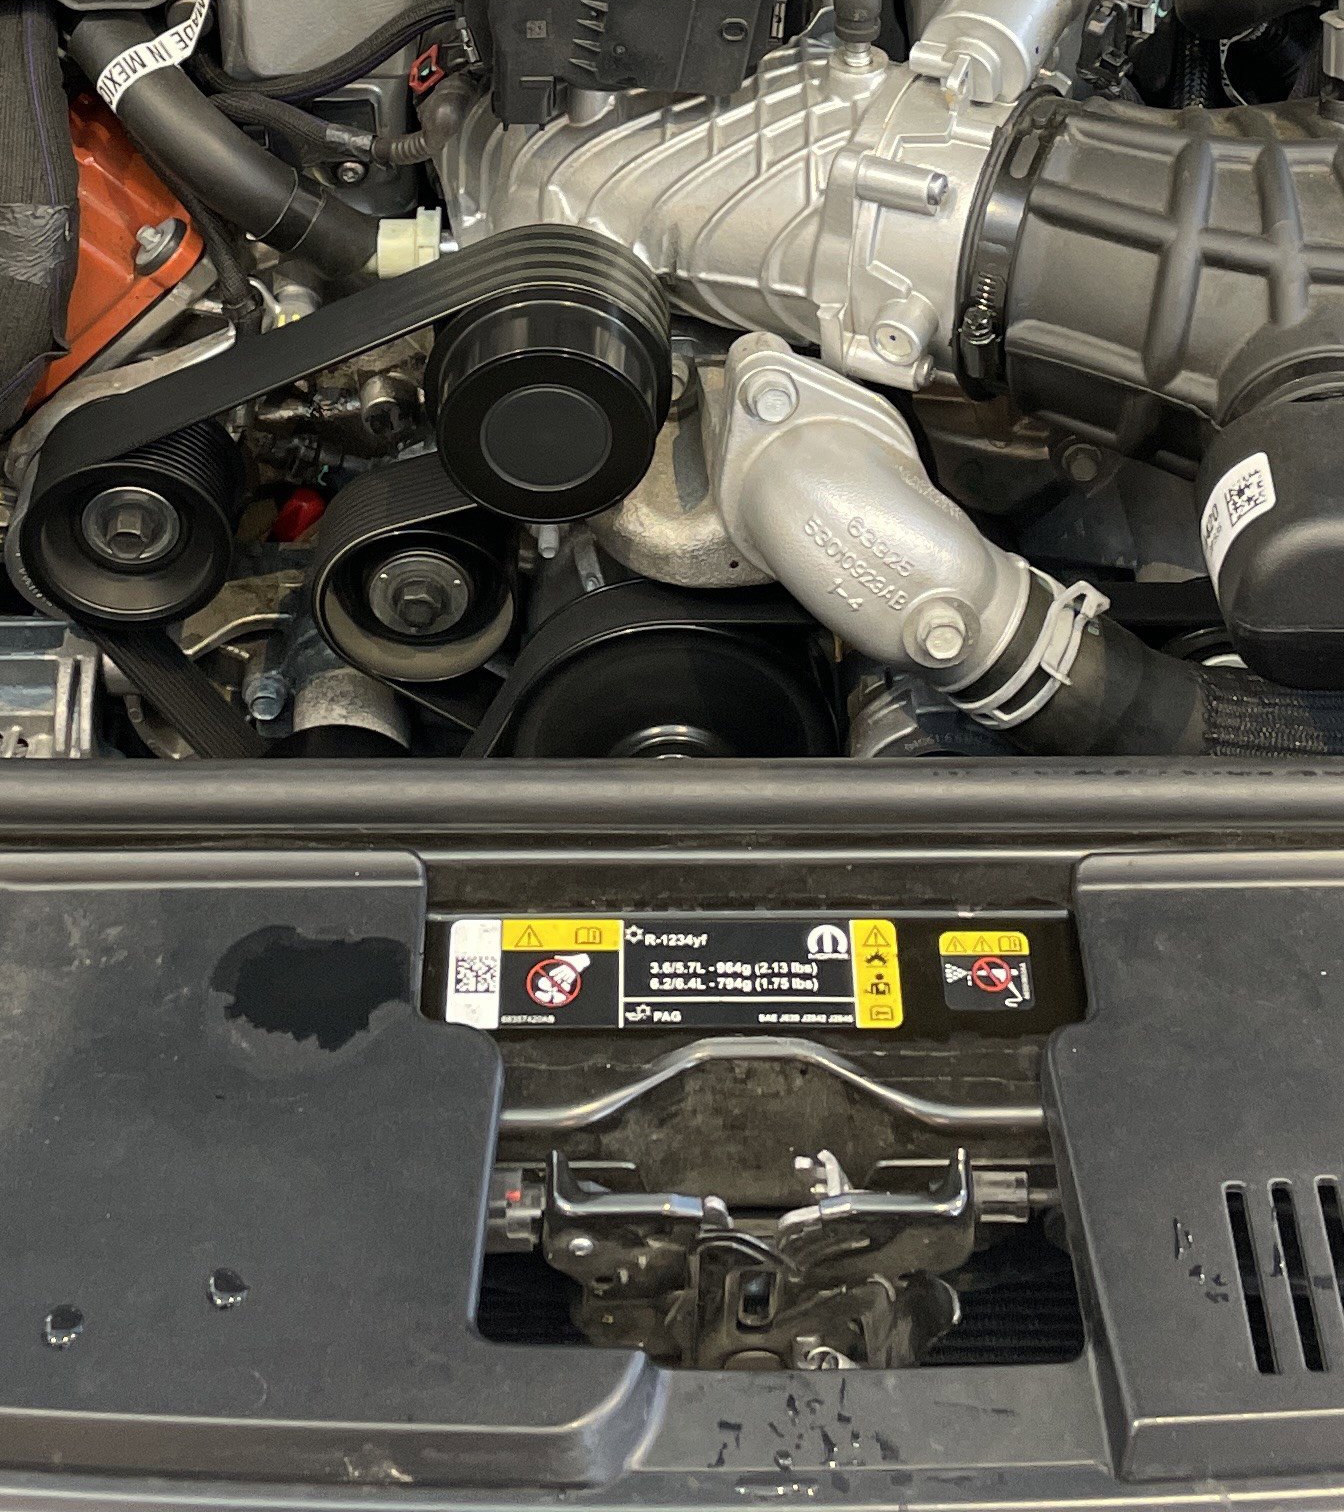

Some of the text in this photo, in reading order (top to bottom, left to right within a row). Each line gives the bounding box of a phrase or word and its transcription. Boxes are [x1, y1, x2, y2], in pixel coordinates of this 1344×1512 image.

[146, 40, 173, 63] IN
[644, 934, 708, 948] R-1234yf
[649, 961, 706, 975] 3.6/5.7L
[716, 961, 752, 976] 964g
[754, 961, 789, 976] (2.13
[790, 961, 819, 976] lbs)
[649, 977, 706, 990] 6.2/6.4L
[717, 977, 752, 992] 794g
[754, 977, 790, 992] (1.75
[790, 977, 819, 992] lbs)
[653, 1011, 682, 1023] PAG
